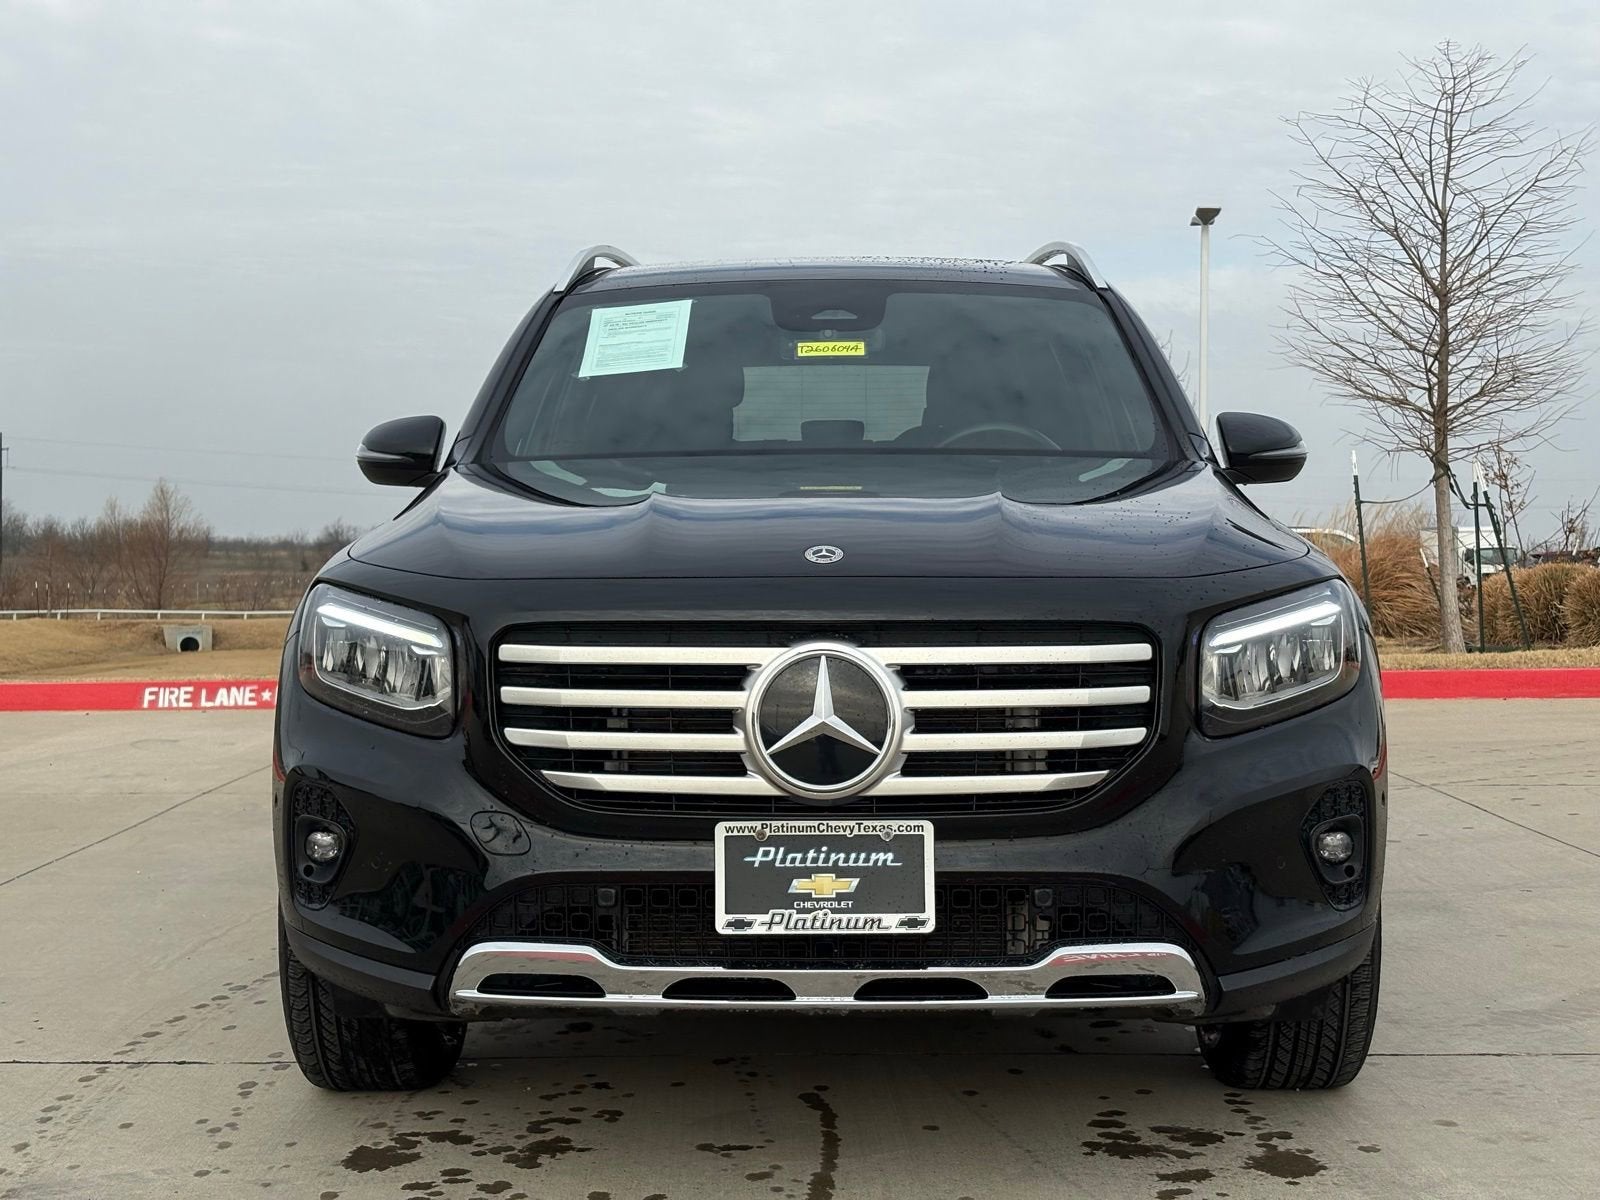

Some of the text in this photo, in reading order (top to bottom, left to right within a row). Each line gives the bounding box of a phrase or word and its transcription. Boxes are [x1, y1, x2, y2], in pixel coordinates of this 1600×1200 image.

[143, 685, 258, 708] FIRE LANE
[724, 822, 924, 834] wwwPlatinumChevyTexas.com
[743, 846, 903, 868] Platinum
[794, 900, 853, 909] CHEVROLET
[758, 911, 892, 932] Platinum
